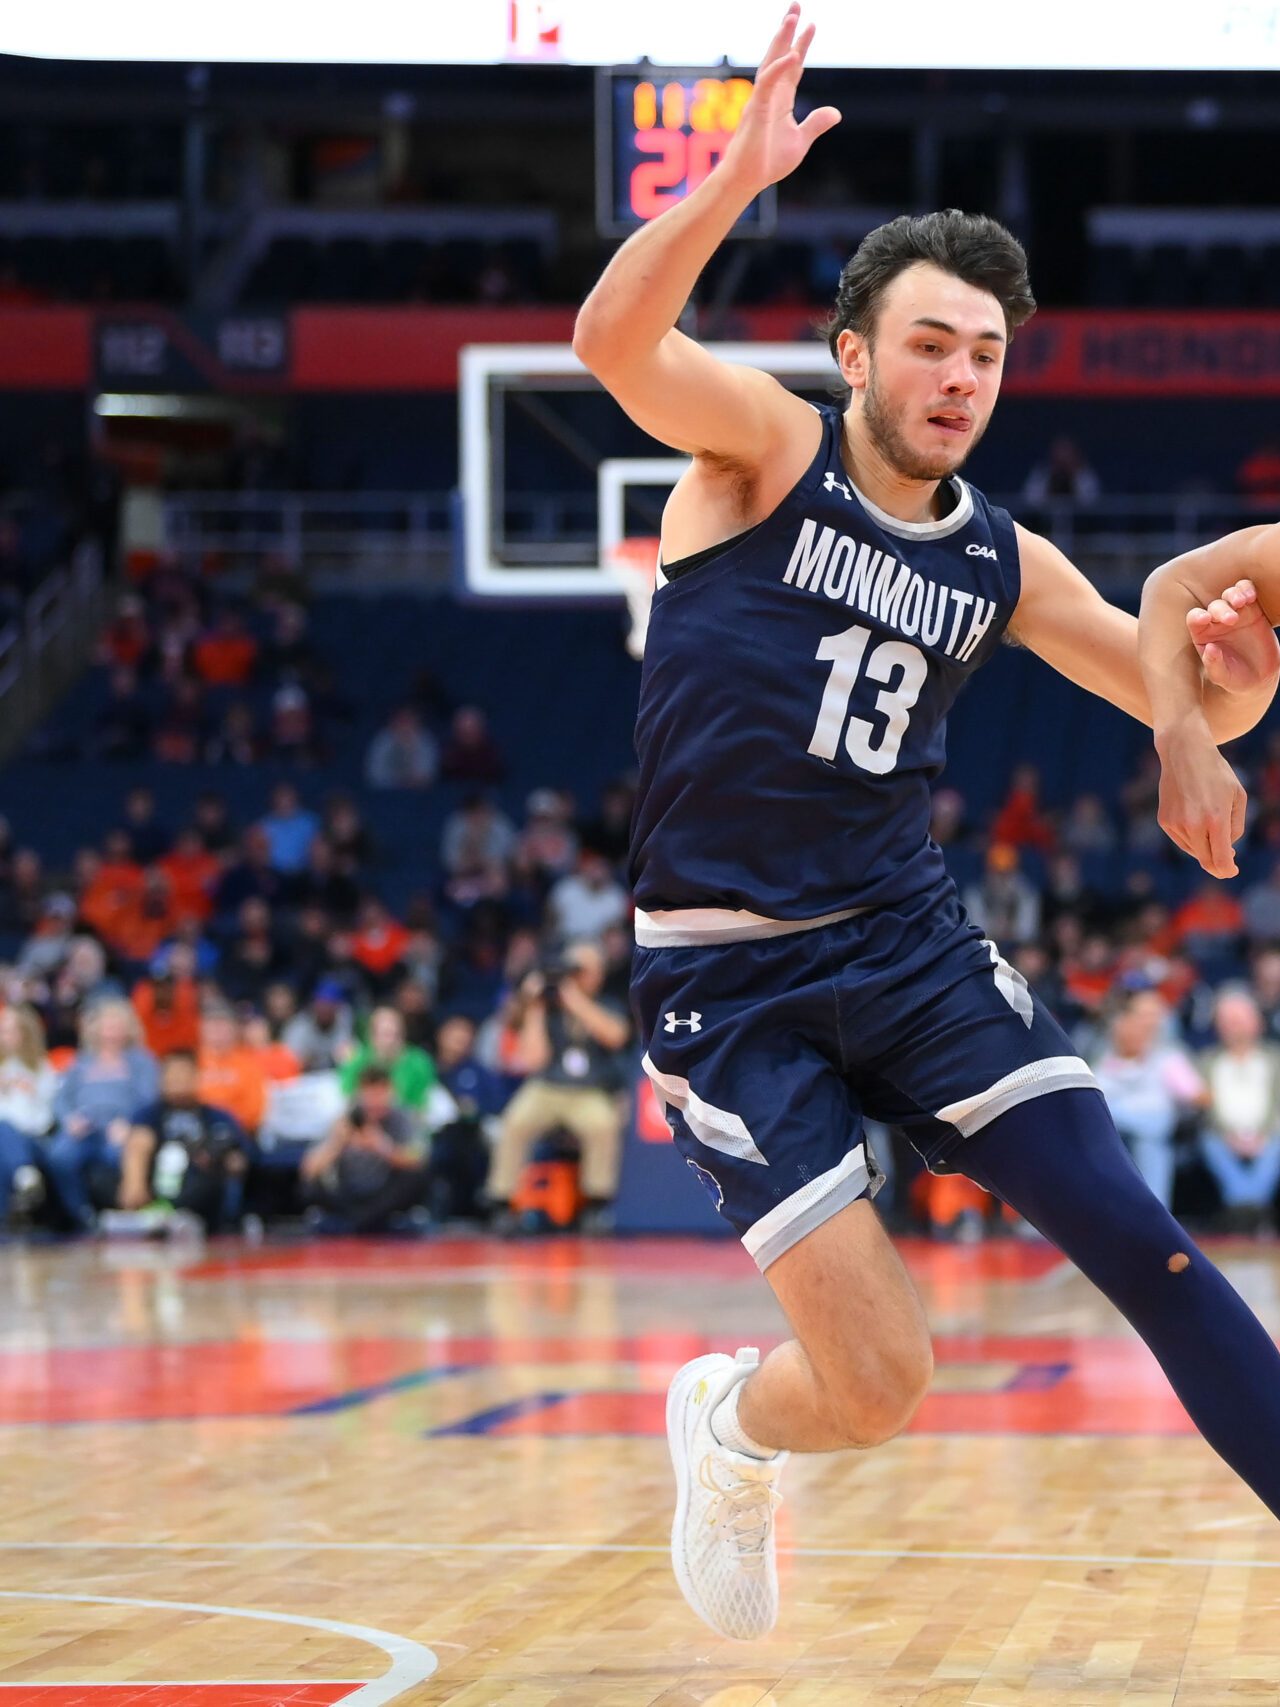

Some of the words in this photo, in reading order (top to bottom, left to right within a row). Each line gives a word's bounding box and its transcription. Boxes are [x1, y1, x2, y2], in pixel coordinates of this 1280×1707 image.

[782, 518, 996, 662] MONMOUTH
[965, 543, 998, 561] CAA
[807, 624, 928, 775] 13
